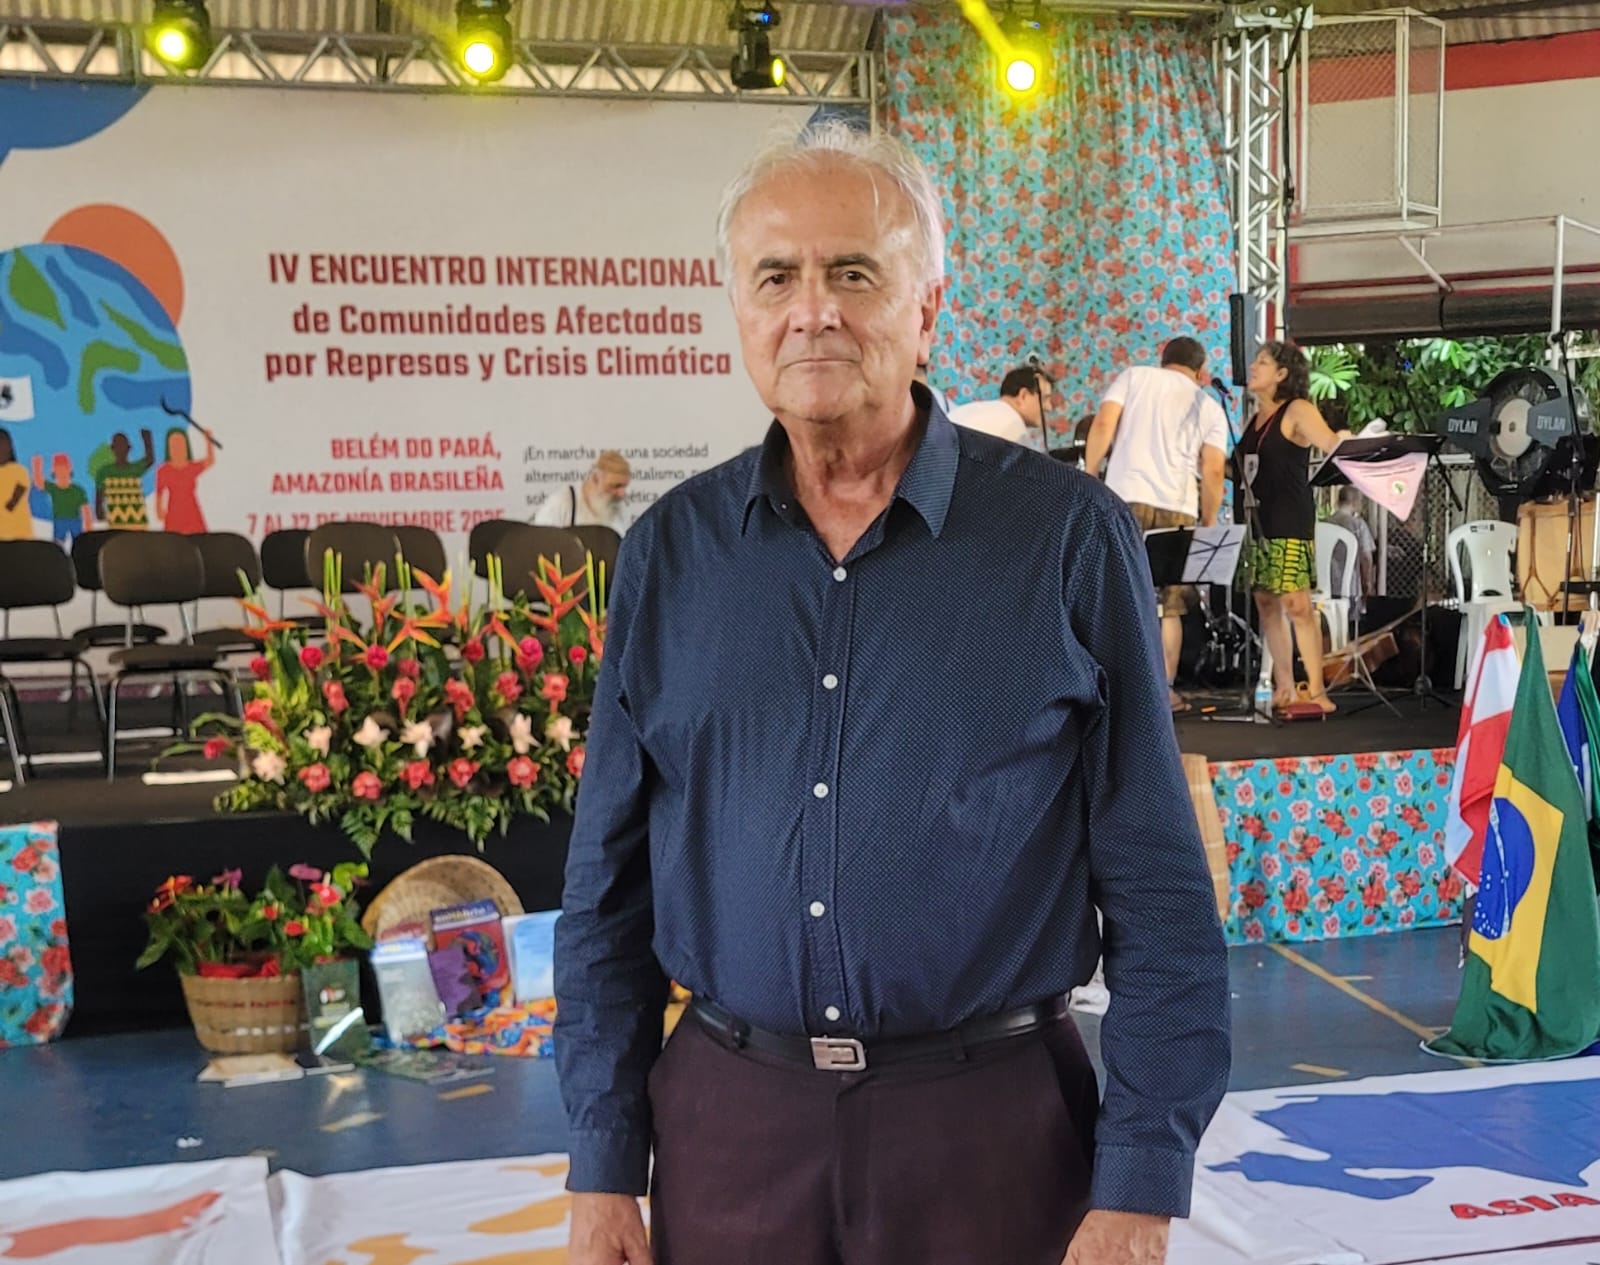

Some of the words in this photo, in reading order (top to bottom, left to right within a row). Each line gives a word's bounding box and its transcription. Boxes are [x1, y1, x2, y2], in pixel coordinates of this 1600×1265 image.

[269, 253, 299, 283] IV
[310, 254, 486, 286] ENCUENTRO
[496, 256, 722, 288] INTERNACIONAL
[293, 304, 330, 334] de
[339, 305, 545, 335] Comunidades
[555, 305, 702, 335] Afectadas
[265, 352, 316, 382] por
[326, 347, 470, 382] Represas
[479, 353, 495, 381] y
[504, 347, 588, 376] Crisis
[597, 346, 731, 376] Climática
[1447, 418, 1478, 434] DYLAN
[1536, 415, 1566, 431] DYLAN
[330, 433, 400, 460] BELÉM
[405, 438, 434, 458] DO
[438, 432, 502, 461] PARÁ,
[547, 446, 596, 460] marcha
[625, 448, 648, 458] una
[652, 443, 709, 458] sociedad
[271, 467, 384, 494] AMAZONÍA
[389, 465, 504, 492] BRASILEÑA
[247, 512, 257, 535] 7
[1450, 1192, 1600, 1219] ASIA
